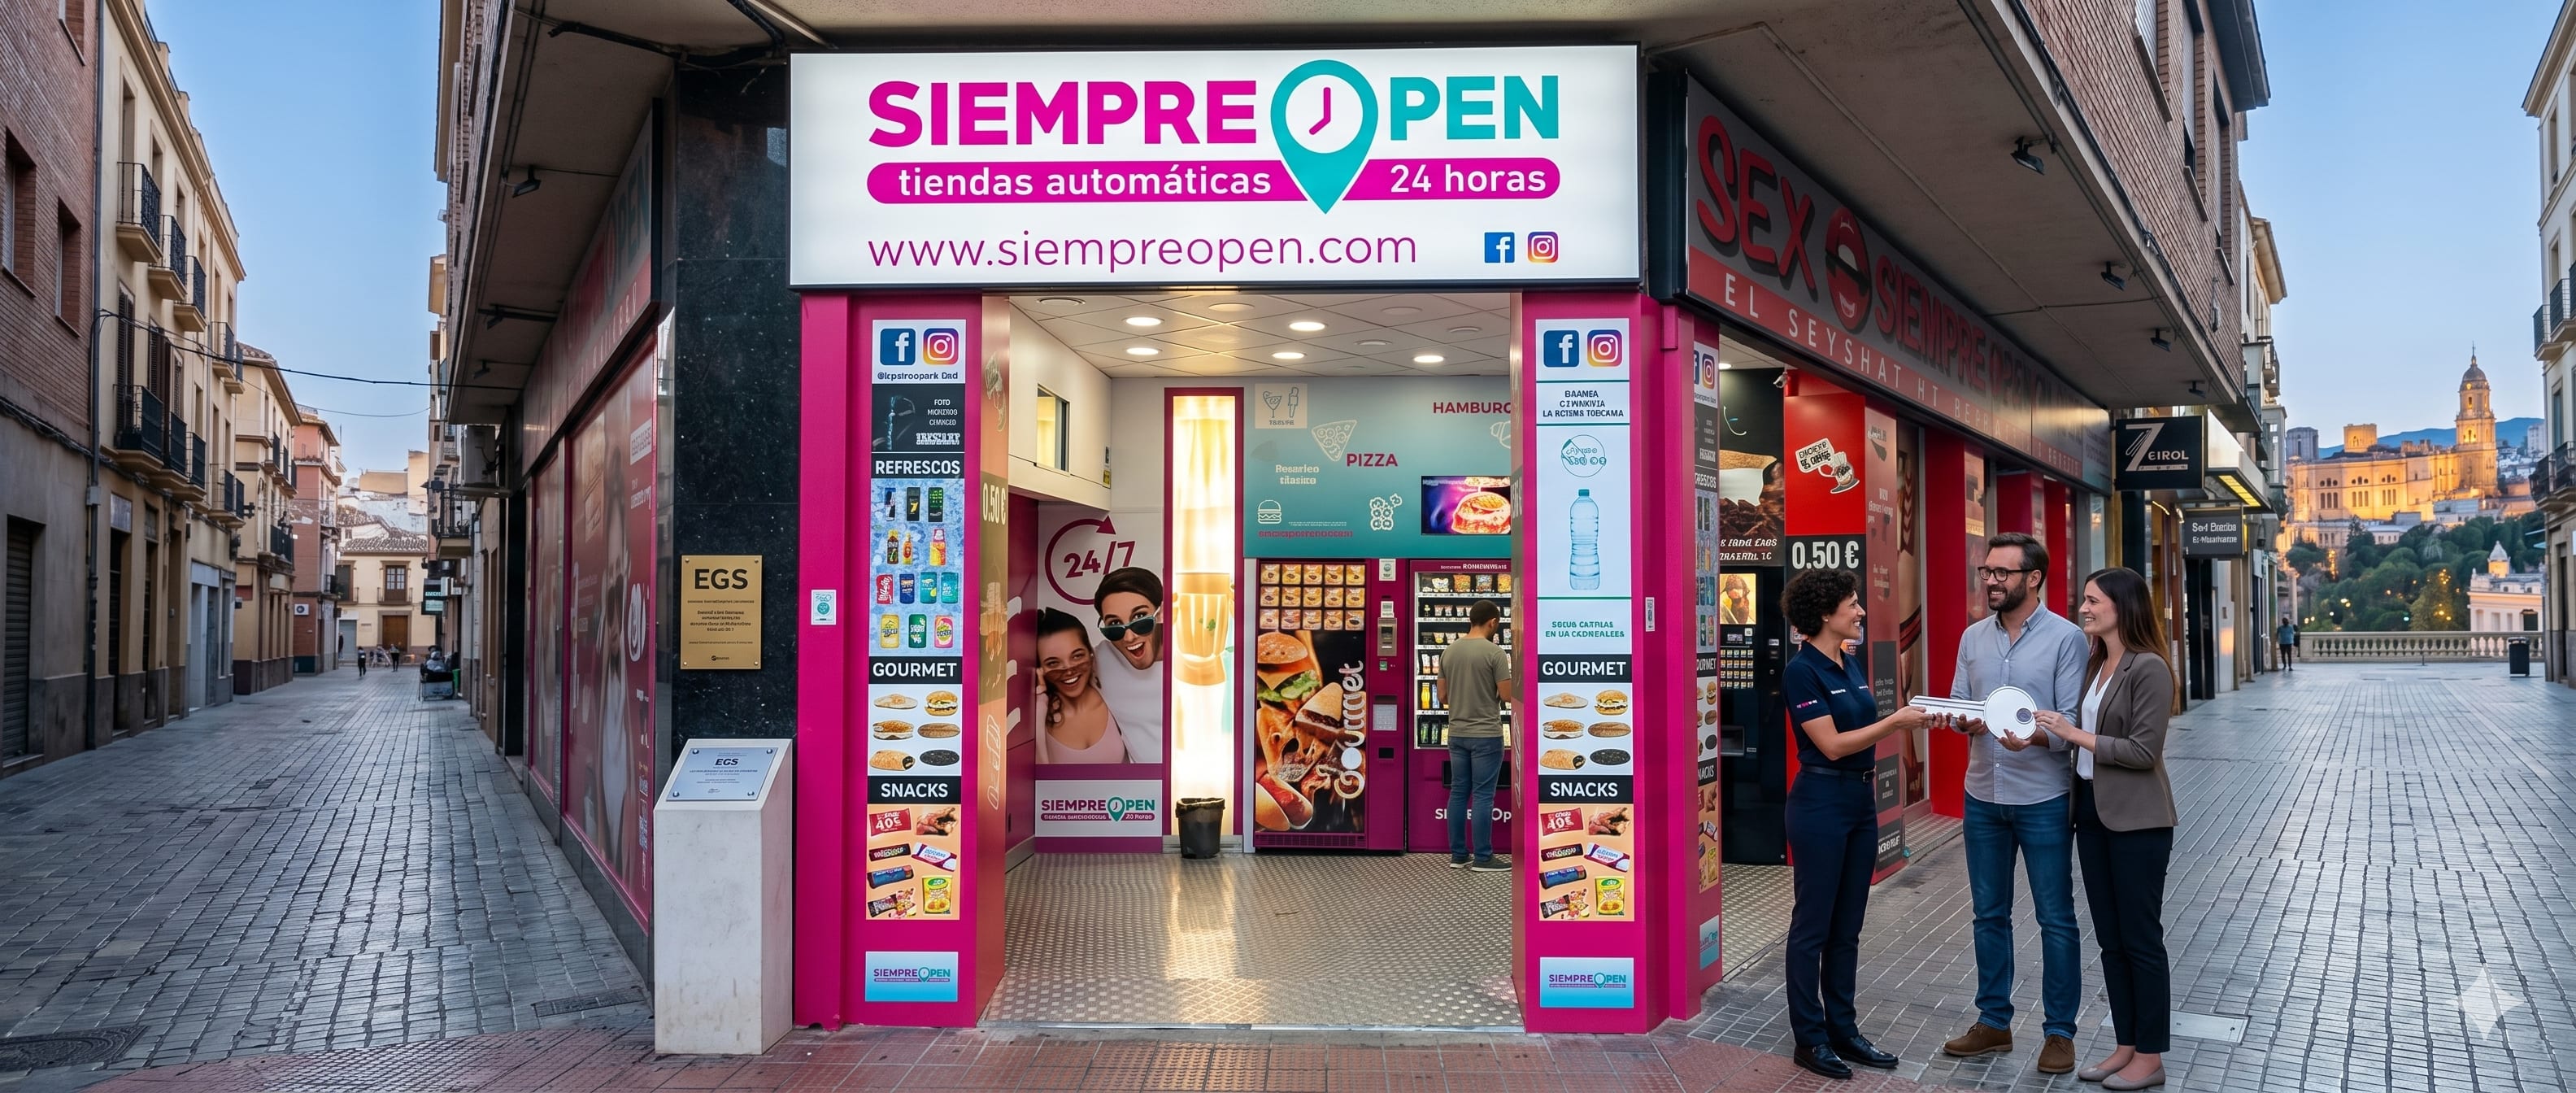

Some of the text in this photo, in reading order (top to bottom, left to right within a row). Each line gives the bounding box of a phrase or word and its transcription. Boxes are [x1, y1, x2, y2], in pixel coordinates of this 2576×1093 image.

[868, 81, 1256, 147] SIEMPRE
[899, 163, 1271, 196] tiendas automáticas
[1391, 164, 1547, 193] 24 horas
[1696, 115, 1817, 291] SEX
[868, 231, 1416, 275] www.siempreopen.com
[1725, 272, 1759, 318] EL
[875, 459, 960, 475] REFRESCOS
[1347, 453, 1398, 467] PIZZA
[1064, 541, 1136, 578] 24/7
[1791, 541, 1840, 569] 0.50
[694, 568, 748, 590] EGS
[872, 662, 957, 677] GOURMET
[1542, 660, 1626, 677] GOURMET
[881, 782, 948, 798] SNACKS
[1550, 782, 1618, 797] SNACKS
[1041, 799, 1107, 811] SIEMPRE
[873, 969, 918, 977] SIEMPRE
[1548, 974, 1594, 982] SIEMPRE
